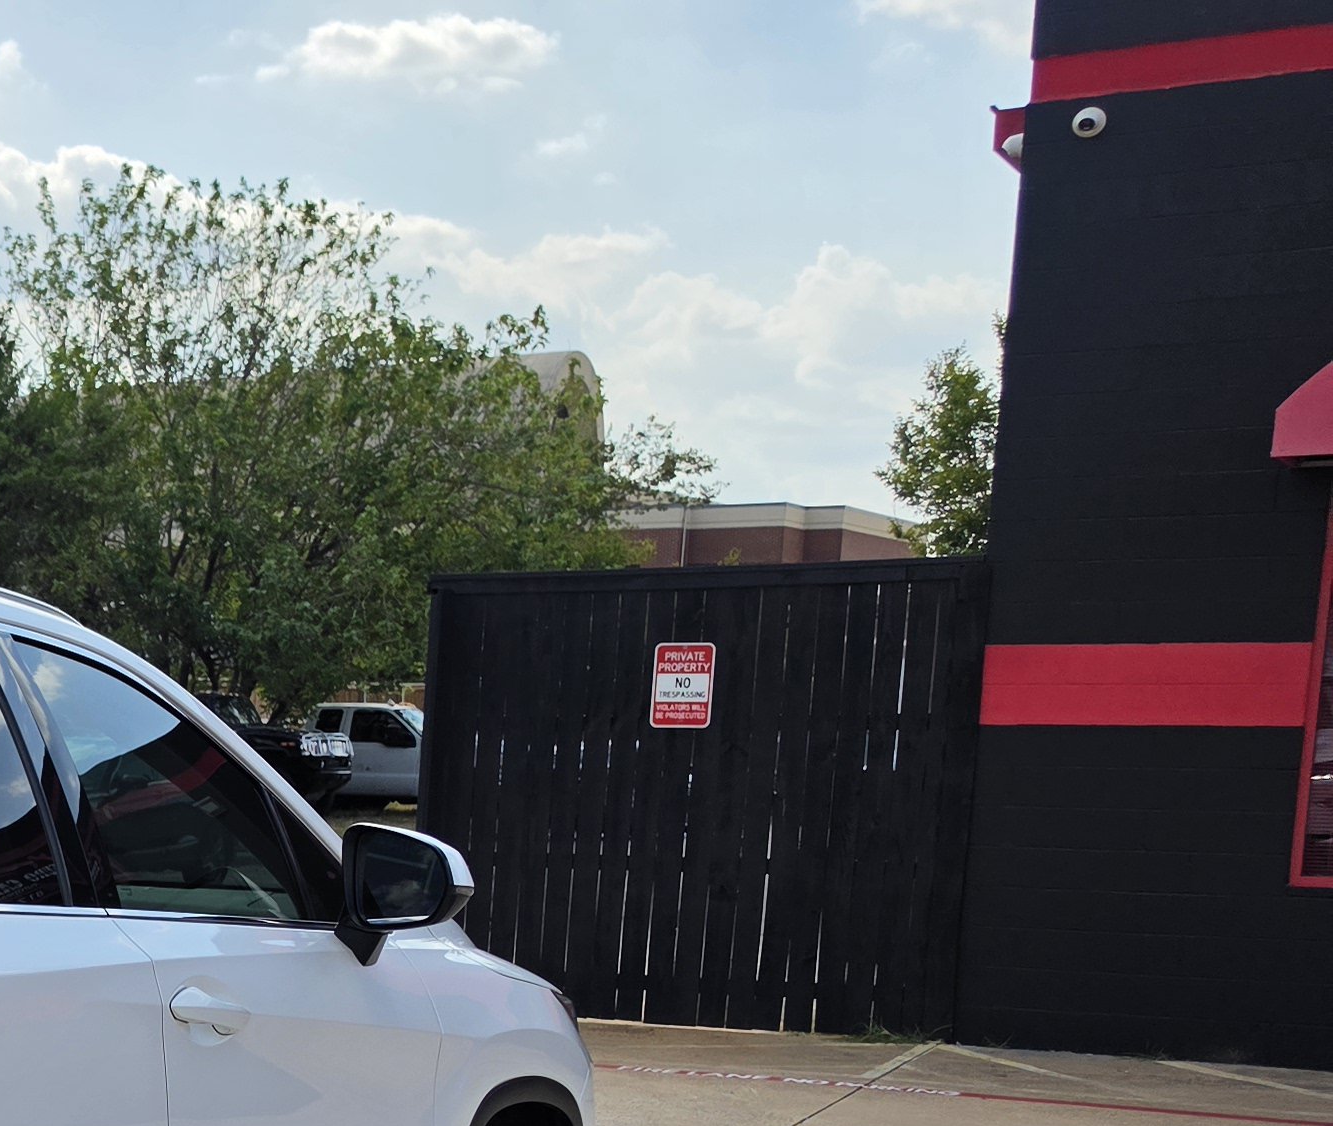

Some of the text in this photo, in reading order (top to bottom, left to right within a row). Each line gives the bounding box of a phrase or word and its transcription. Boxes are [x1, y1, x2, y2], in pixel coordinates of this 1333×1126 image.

[664, 651, 706, 661] PRIVATE
[657, 662, 711, 673] PROPERTY
[674, 677, 691, 689] NO
[659, 691, 706, 699] TRESPASSING
